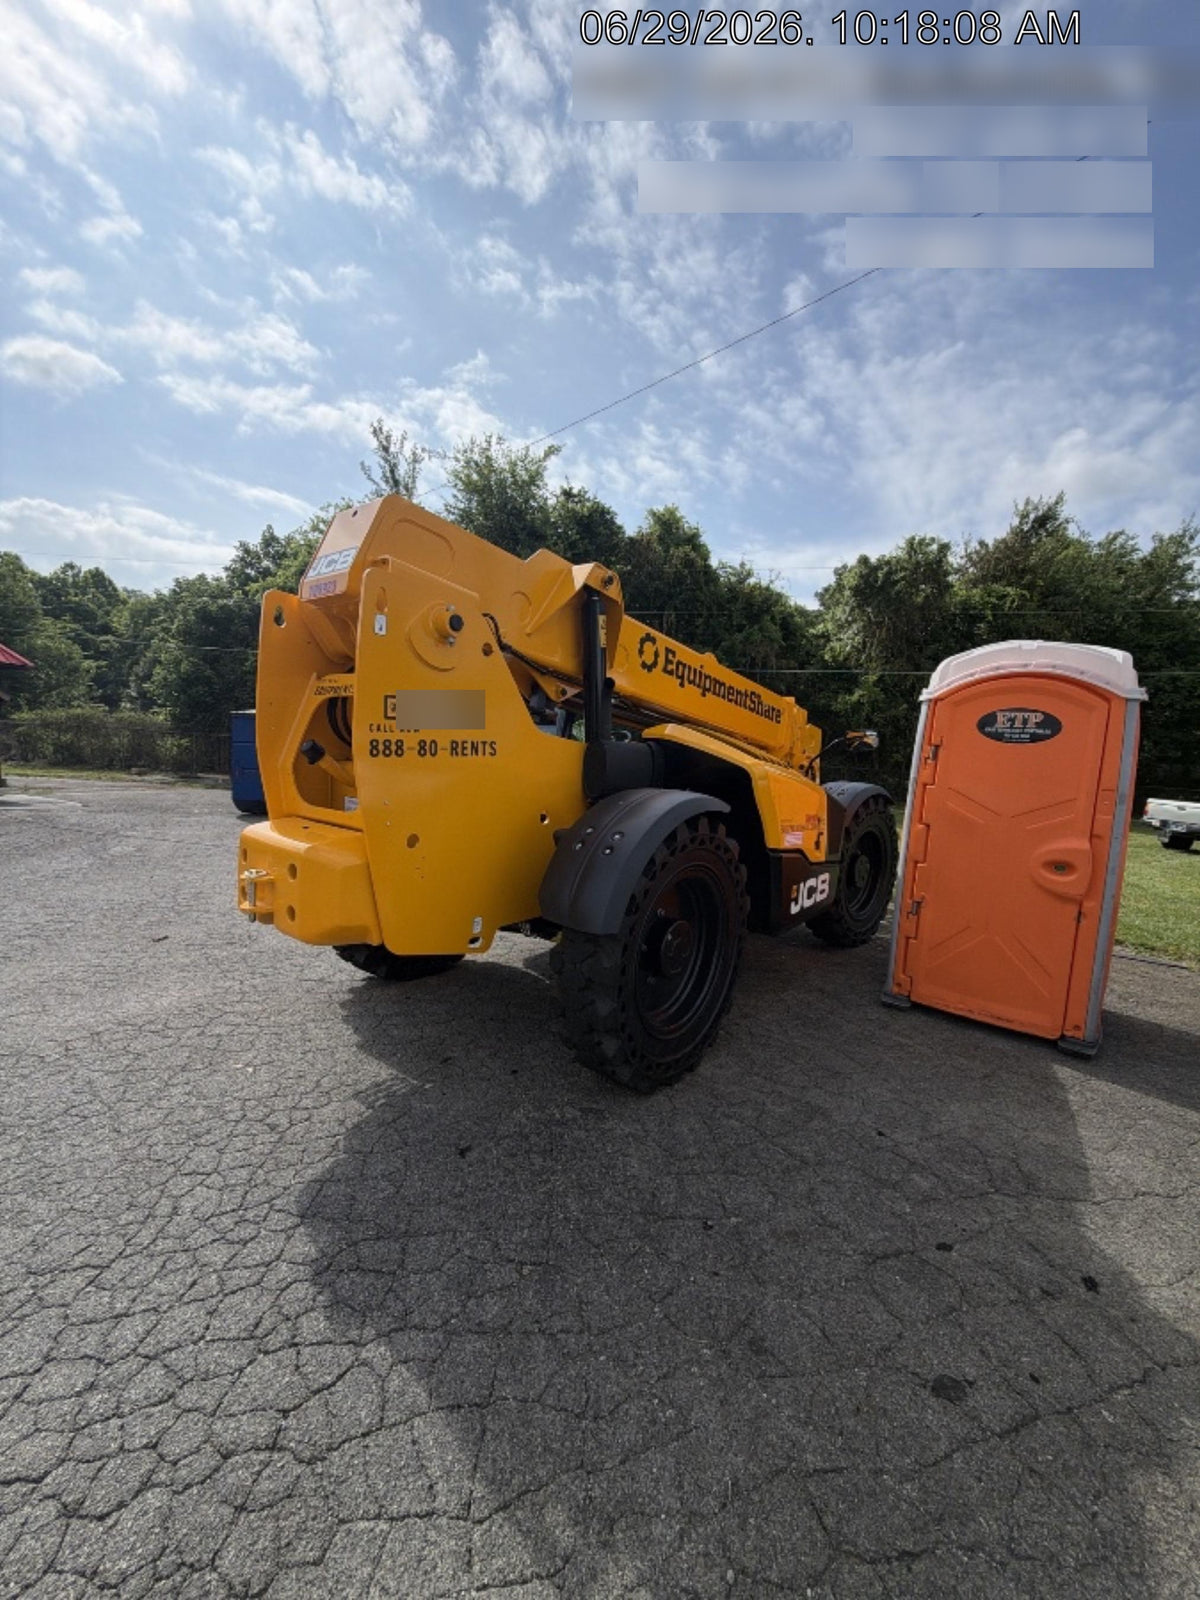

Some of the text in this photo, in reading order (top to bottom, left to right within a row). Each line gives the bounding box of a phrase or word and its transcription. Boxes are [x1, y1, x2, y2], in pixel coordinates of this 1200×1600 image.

[307, 547, 358, 577] JCB
[662, 646, 782, 724] EquipmentShare
[369, 723, 395, 733] CALL
[995, 711, 1044, 728] ETP
[369, 739, 497, 757] 888-80-RENTS
[790, 872, 830, 915] JCB
